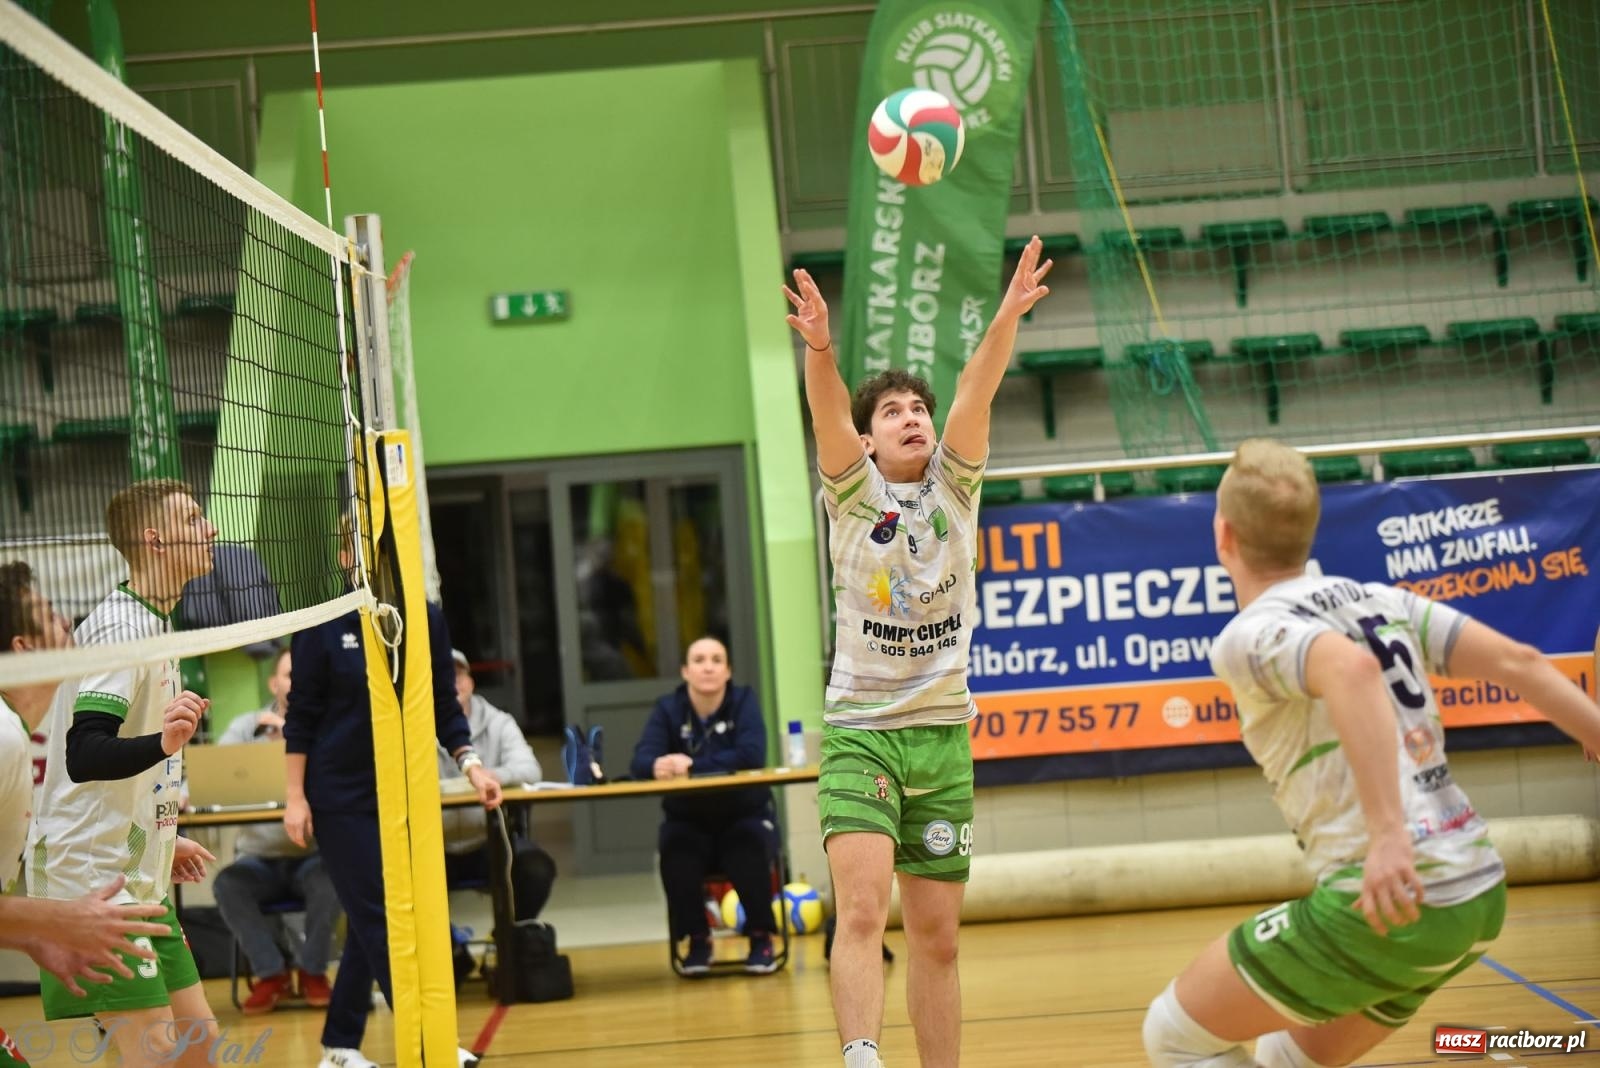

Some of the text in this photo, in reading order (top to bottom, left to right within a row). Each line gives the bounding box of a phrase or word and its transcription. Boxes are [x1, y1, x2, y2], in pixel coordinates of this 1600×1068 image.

[895, 12, 1012, 81] KLUB SIATKARSKI
[864, 166, 907, 379] IATKARSK
[1377, 497, 1503, 547] SIATKARZE
[1386, 525, 1538, 580] NAM ZAUFALI.
[1541, 546, 1589, 580] SIĘ
[973, 559, 1322, 630] EZPIECZE
[863, 618, 915, 643] POMPY
[880, 635, 957, 657] 605 944 146
[1075, 635, 1117, 669] ul.
[1013, 708, 1049, 735] 77
[1058, 705, 1096, 732] 55
[1103, 702, 1140, 729] 77
